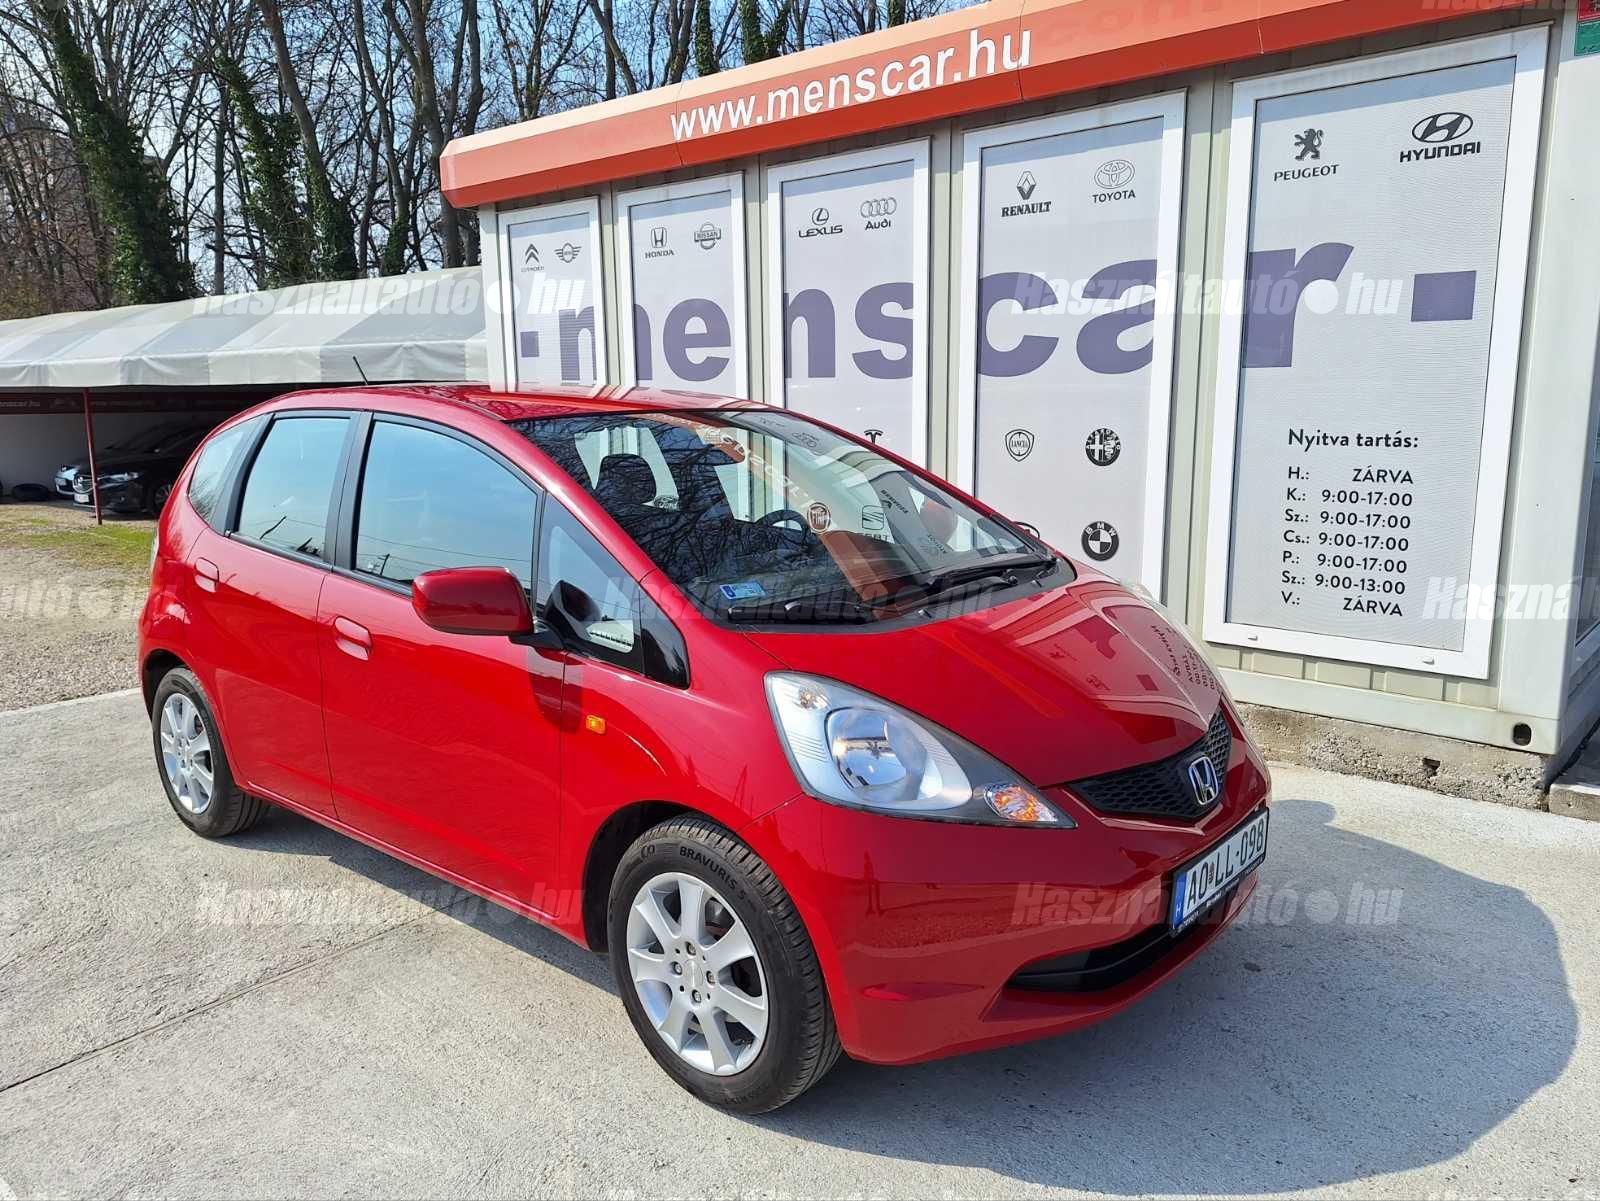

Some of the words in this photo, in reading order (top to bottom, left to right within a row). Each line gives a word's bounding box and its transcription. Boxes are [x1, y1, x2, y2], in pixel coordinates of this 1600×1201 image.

[670, 29, 1032, 142] www.menscar.hu
[1399, 141, 1481, 163] HYUNDAI
[1273, 164, 1340, 182] PEUGEOT
[1092, 189, 1137, 204] TOYOTA
[1001, 200, 1052, 218] RENAULT
[798, 224, 844, 238] LEXUS
[864, 218, 892, 231] Audi
[644, 249, 675, 260] HONDA
[1288, 428, 1349, 452] Nyitva
[1356, 430, 1419, 448] tartás:
[1288, 466, 1310, 480] H.:
[1352, 464, 1414, 484] ZÁRVA
[1287, 487, 1306, 501] K.:
[1321, 489, 1413, 506] 9:00-17:00
[1285, 508, 1309, 522] Sz.:
[1320, 511, 1411, 529] 9:00-17:00
[1085, 522, 1117, 538] BMW
[1283, 530, 1310, 544] Cs.:
[1318, 532, 1409, 551] 9:00-17:00
[1282, 551, 1300, 564] P.:
[1317, 553, 1407, 573] 9:00-17:00
[1281, 571, 1305, 585] Sz.:
[1314, 574, 1405, 595] 9:00-13:00
[1281, 590, 1301, 605] V.:
[1342, 595, 1403, 616] ZÁRVA
[679, 845, 739, 889] BRAVURIS
